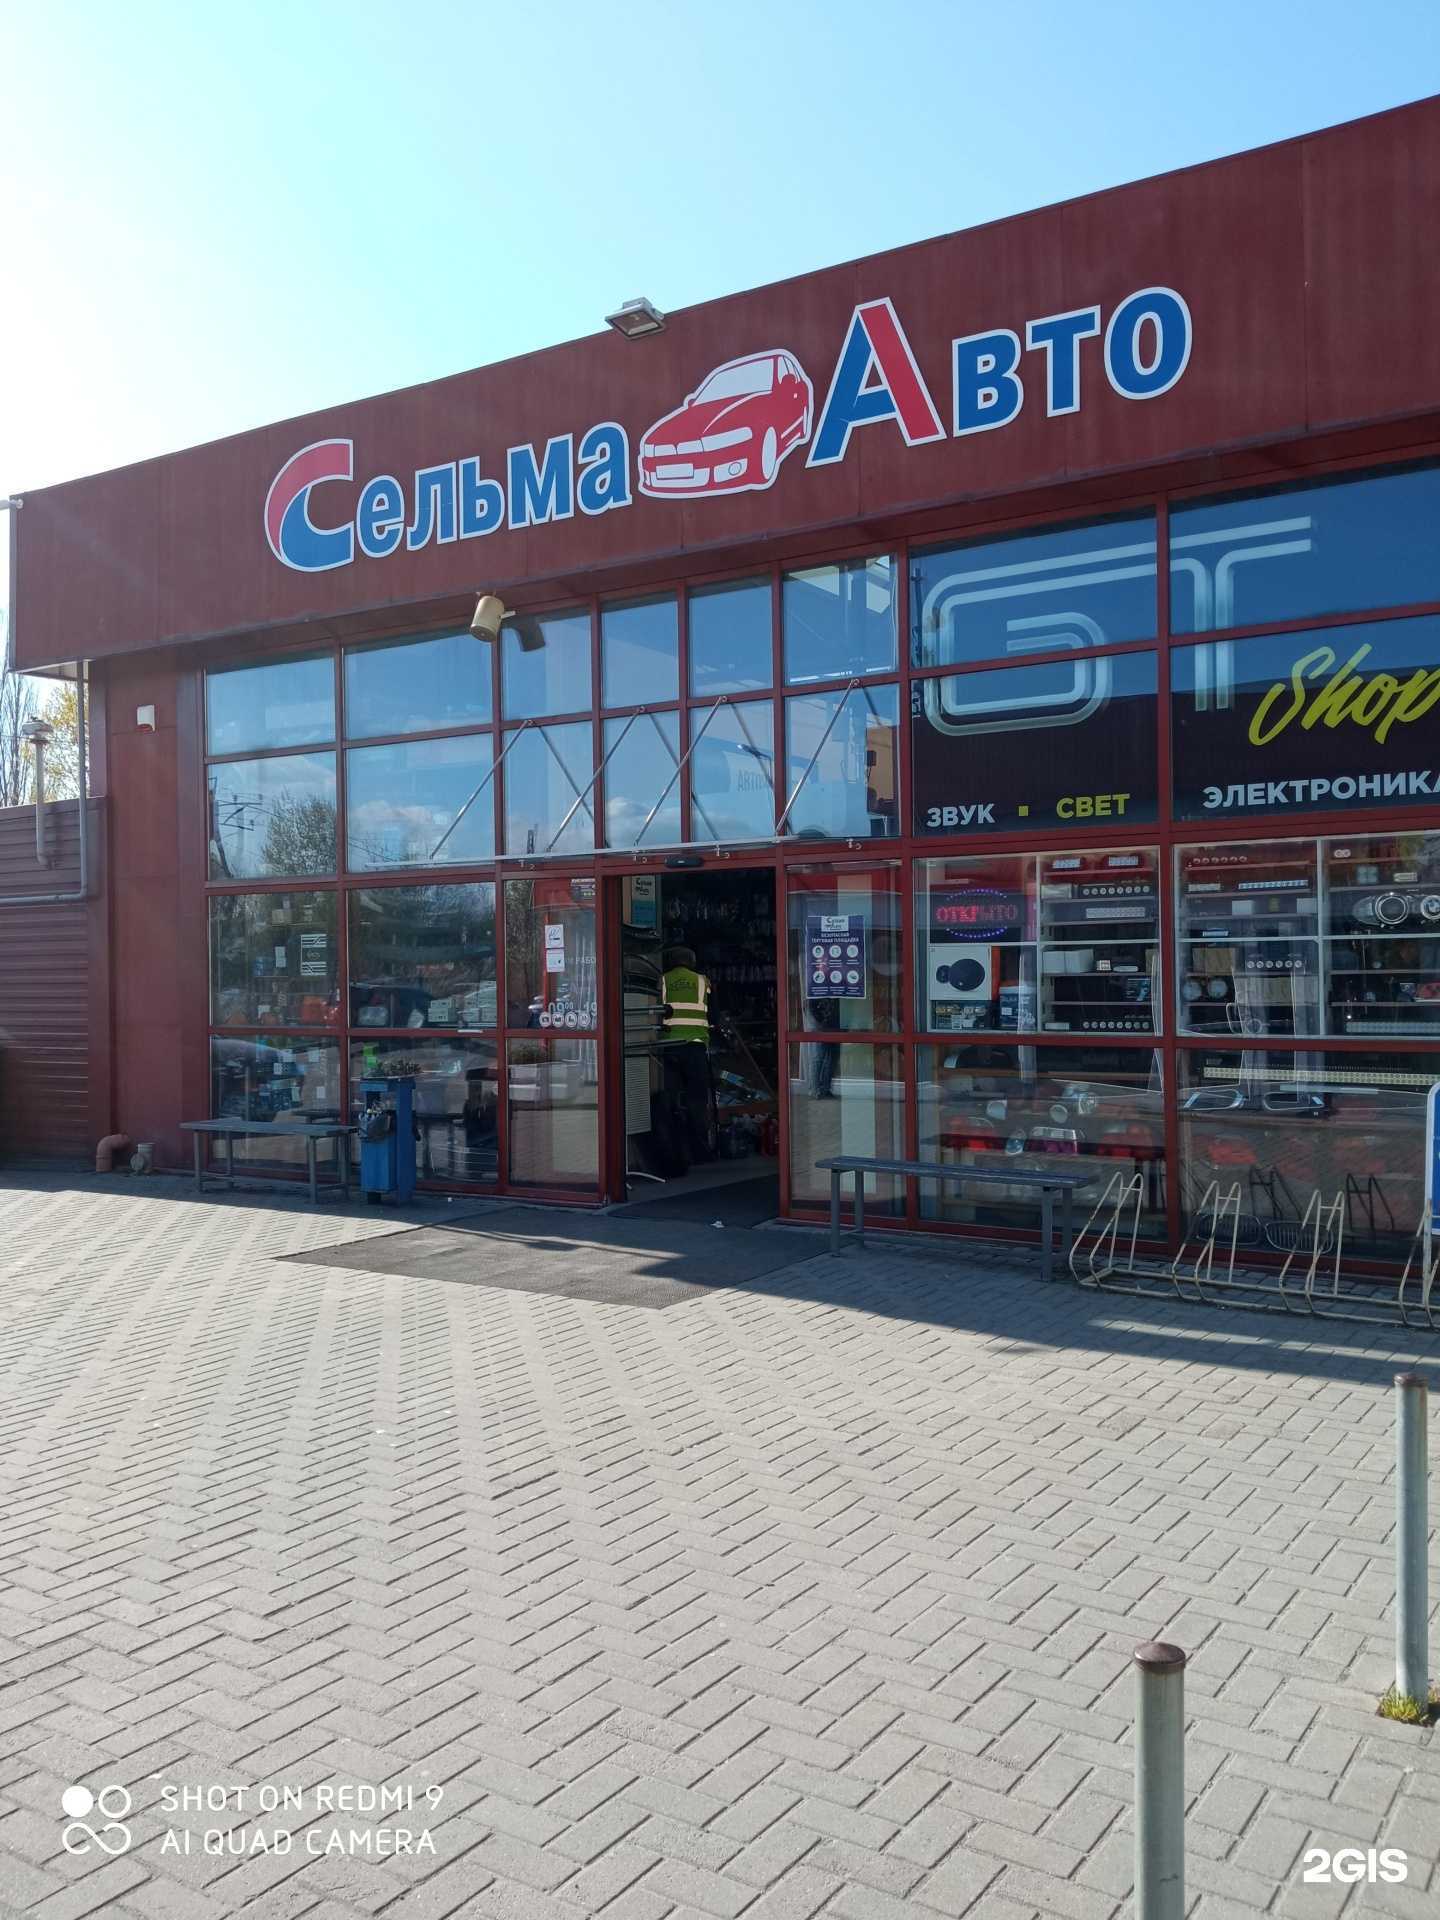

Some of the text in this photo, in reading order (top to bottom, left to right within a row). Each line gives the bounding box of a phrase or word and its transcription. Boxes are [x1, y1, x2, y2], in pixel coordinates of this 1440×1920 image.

[265, 286, 1193, 573] Сельма Авто
[1248, 643, 1440, 746] Shop
[926, 792, 1131, 829] ЗВУК СВЕТ
